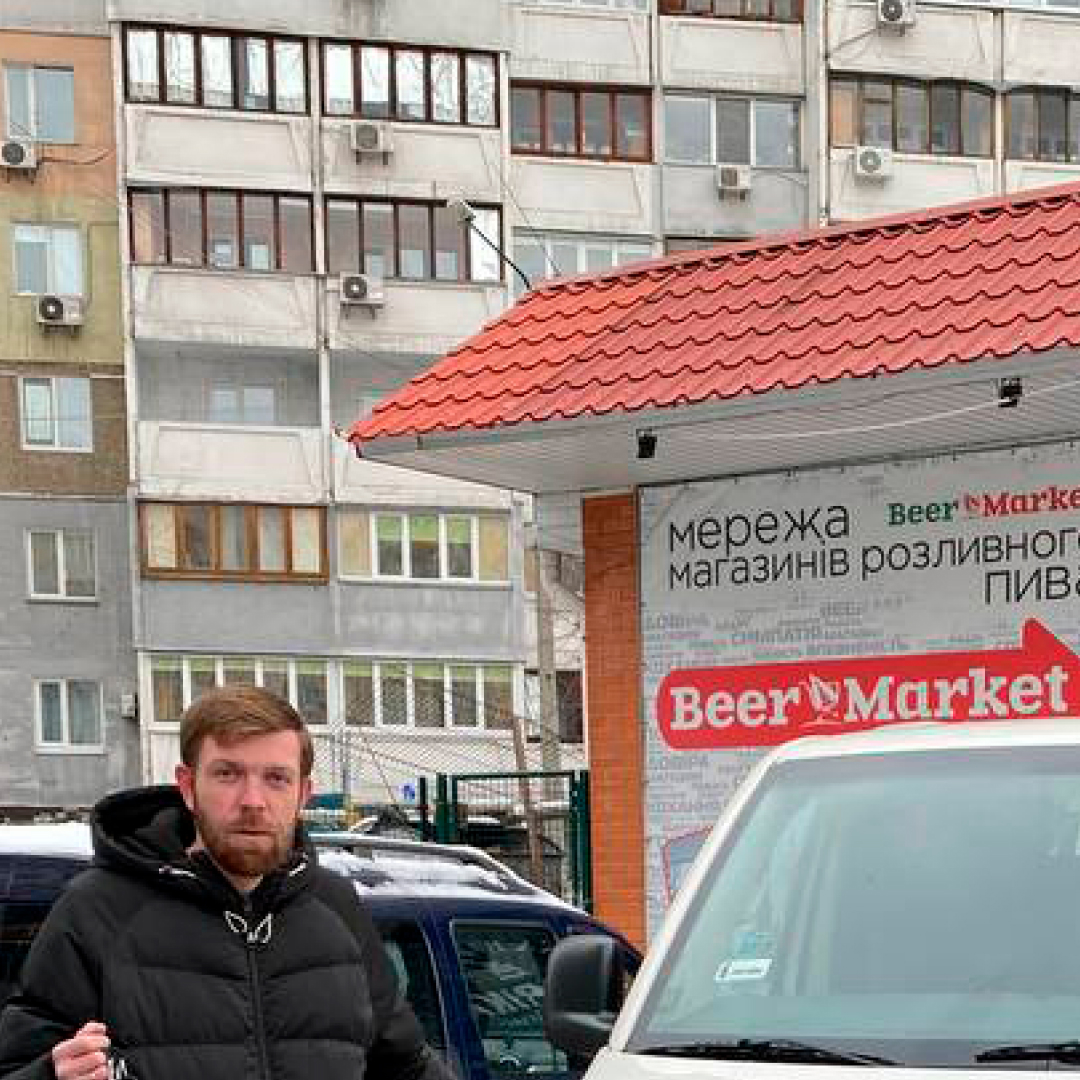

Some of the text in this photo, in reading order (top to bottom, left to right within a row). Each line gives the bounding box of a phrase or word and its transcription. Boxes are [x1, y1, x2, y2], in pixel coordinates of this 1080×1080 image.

[668, 505, 850, 551] мережа
[888, 500, 959, 526] Beer
[668, 541, 850, 590] магазинів
[669, 665, 1069, 731] Beer Market
